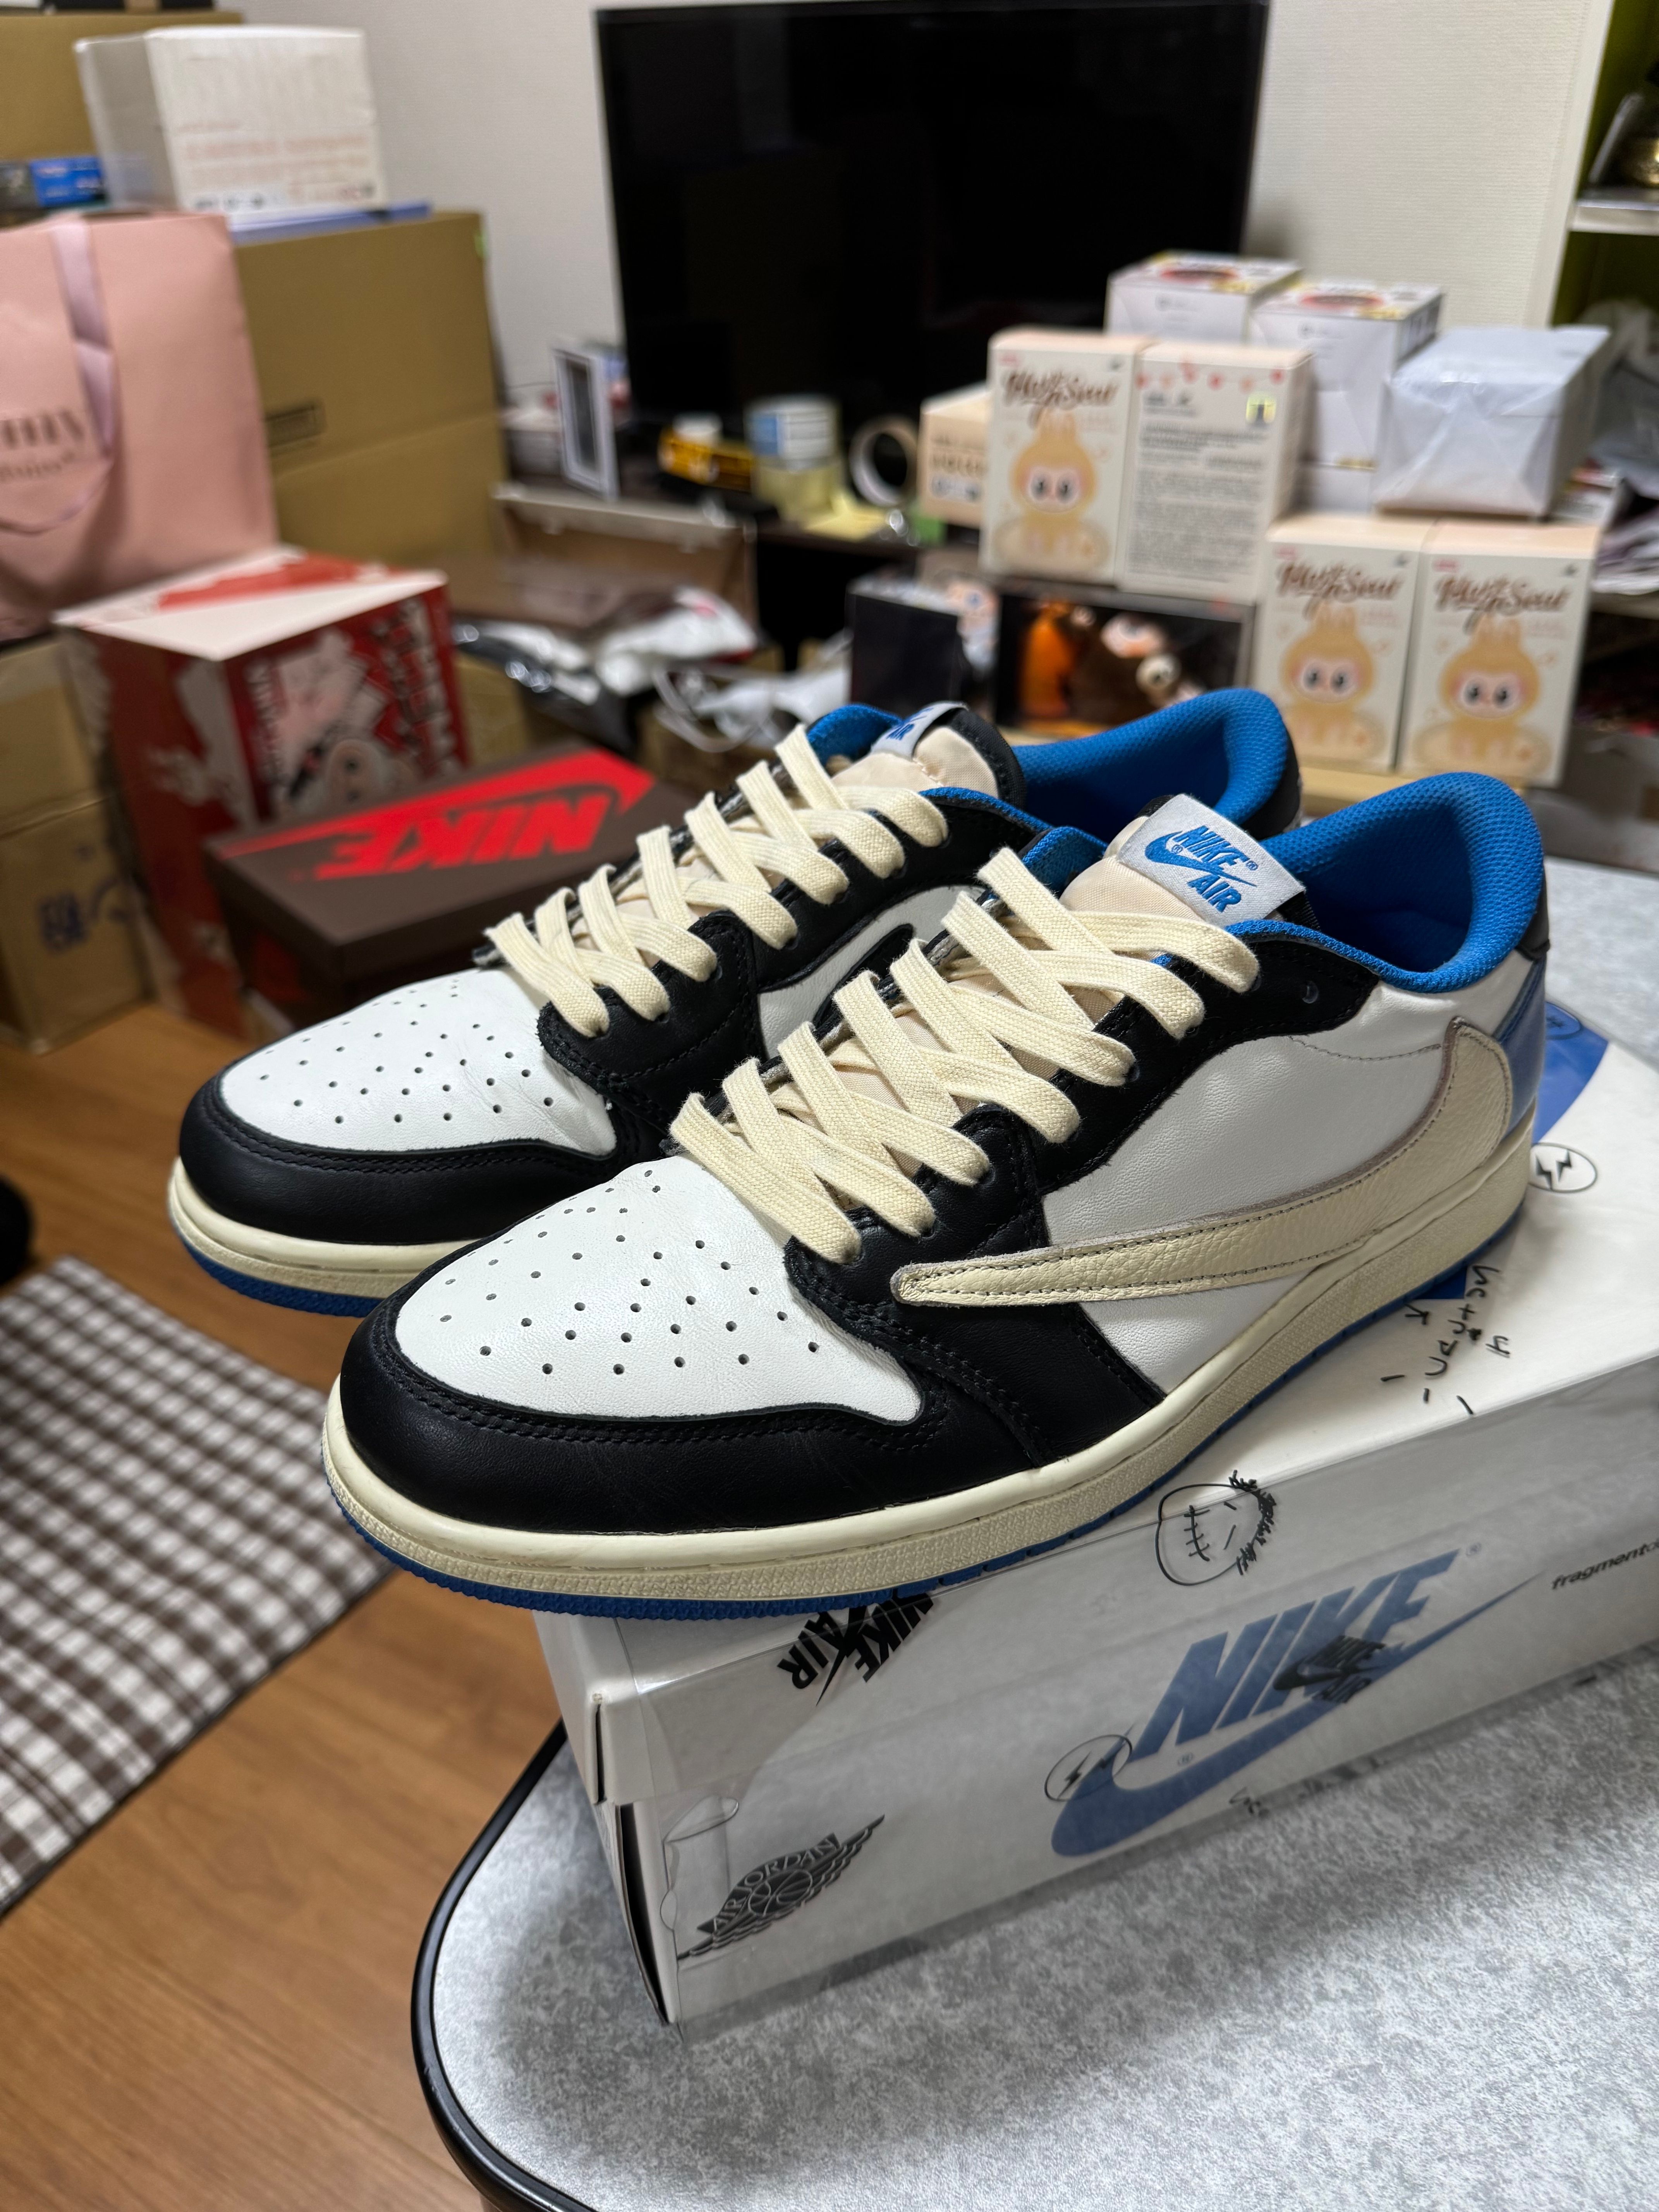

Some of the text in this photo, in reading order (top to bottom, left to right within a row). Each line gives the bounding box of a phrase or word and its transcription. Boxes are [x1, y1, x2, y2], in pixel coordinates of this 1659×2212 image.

[316, 793, 611, 881] NIKE
[1173, 825, 1250, 871] NIKE
[1187, 874, 1242, 913] AIR
[776, 1612, 844, 1689] AIR
[1132, 1549, 1460, 1761] NIKE
[736, 1838, 837, 1905] JORDAN
